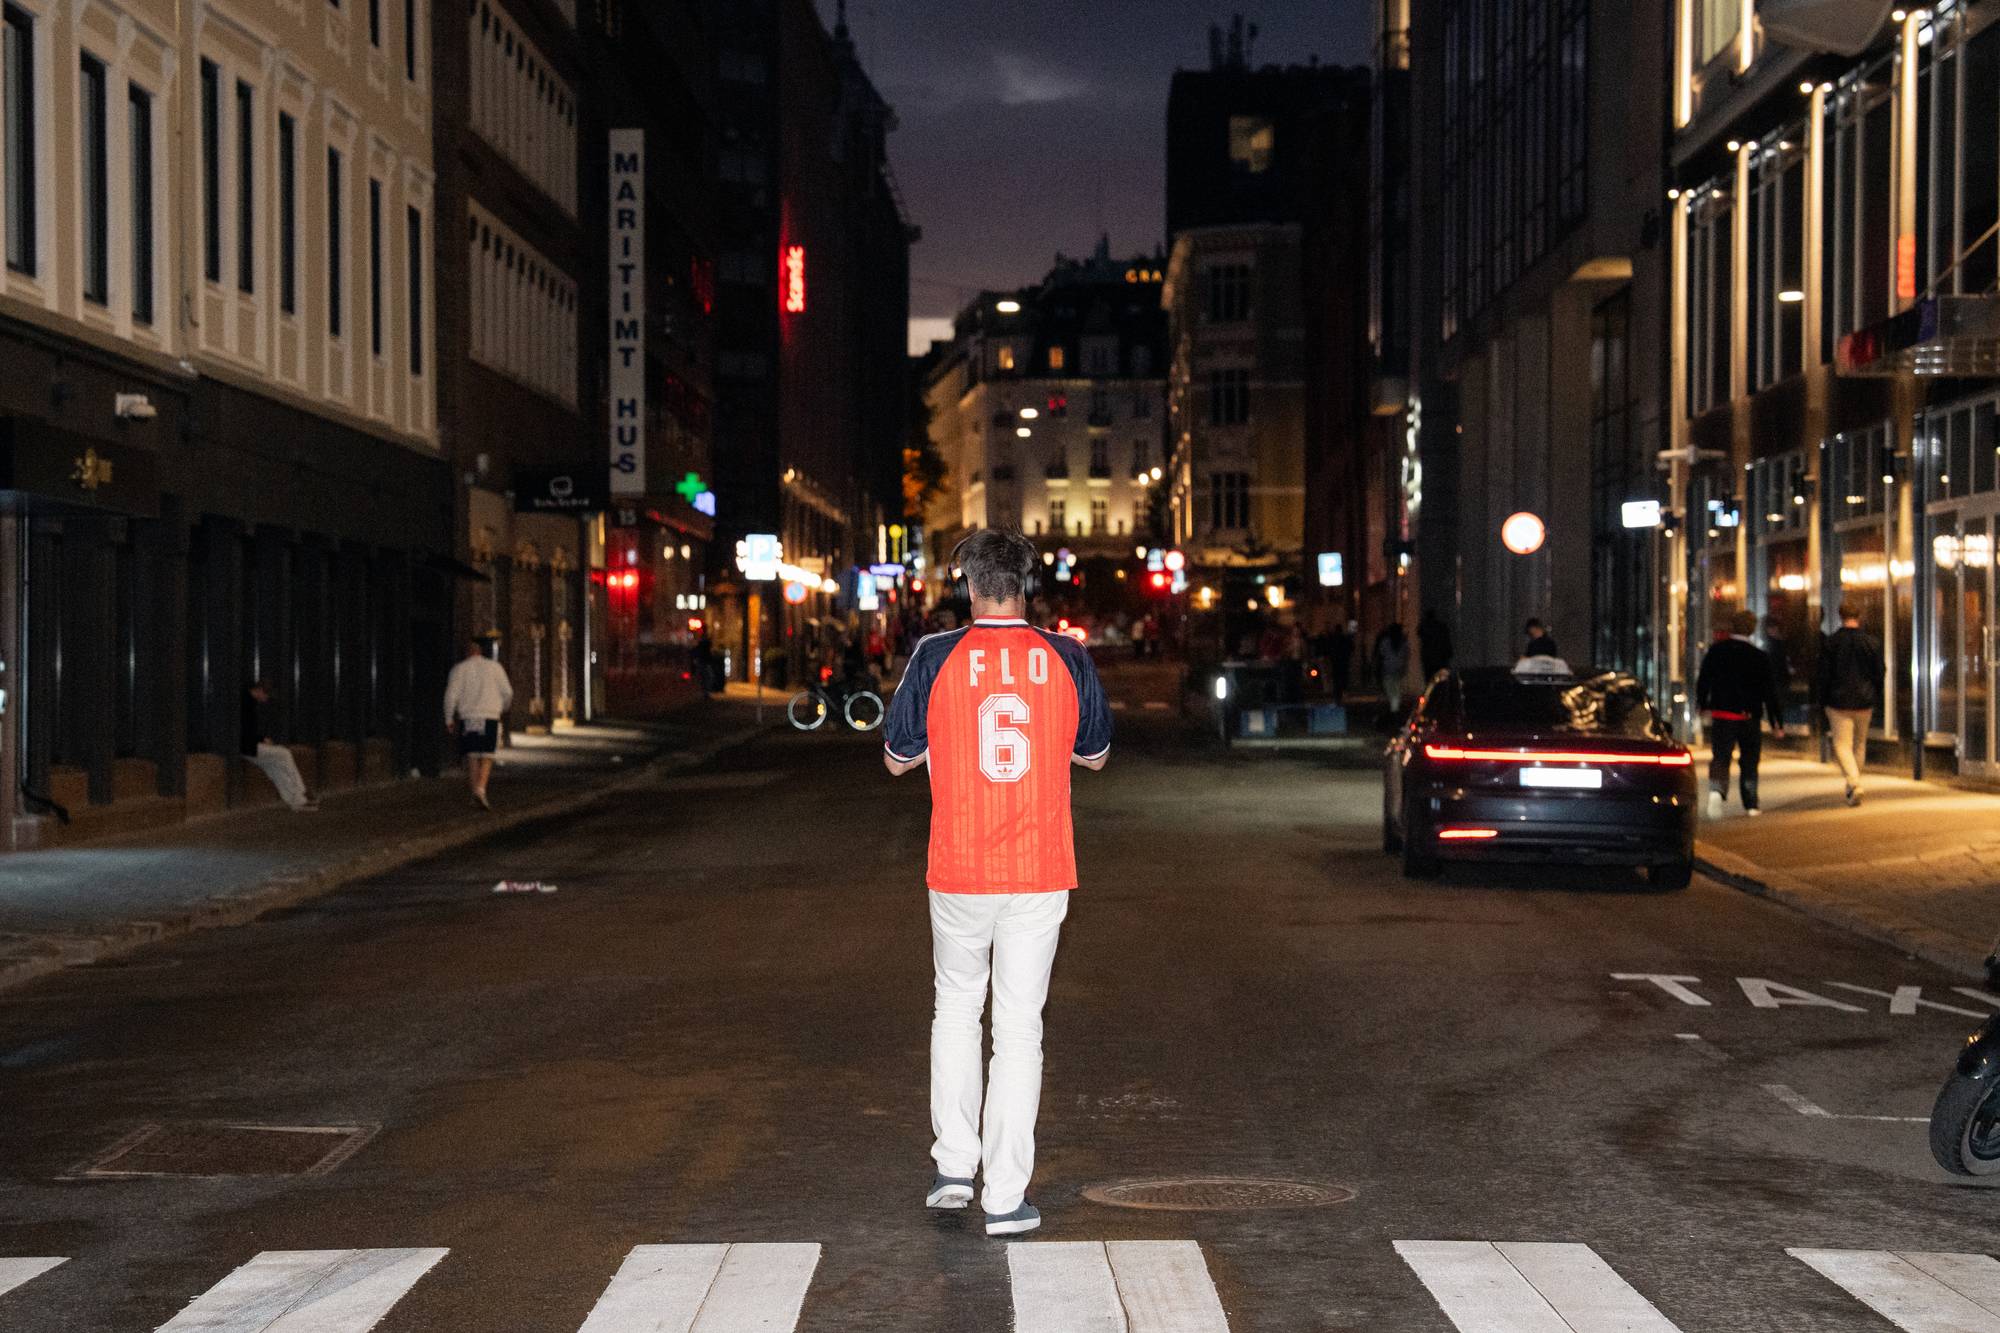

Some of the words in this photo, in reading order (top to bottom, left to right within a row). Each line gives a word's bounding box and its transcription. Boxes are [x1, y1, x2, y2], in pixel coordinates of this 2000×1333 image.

[614, 153, 639, 367] MARITIMT
[615, 399, 637, 473] HUS
[969, 648, 1049, 687] FLO
[978, 694, 1030, 782] 6
